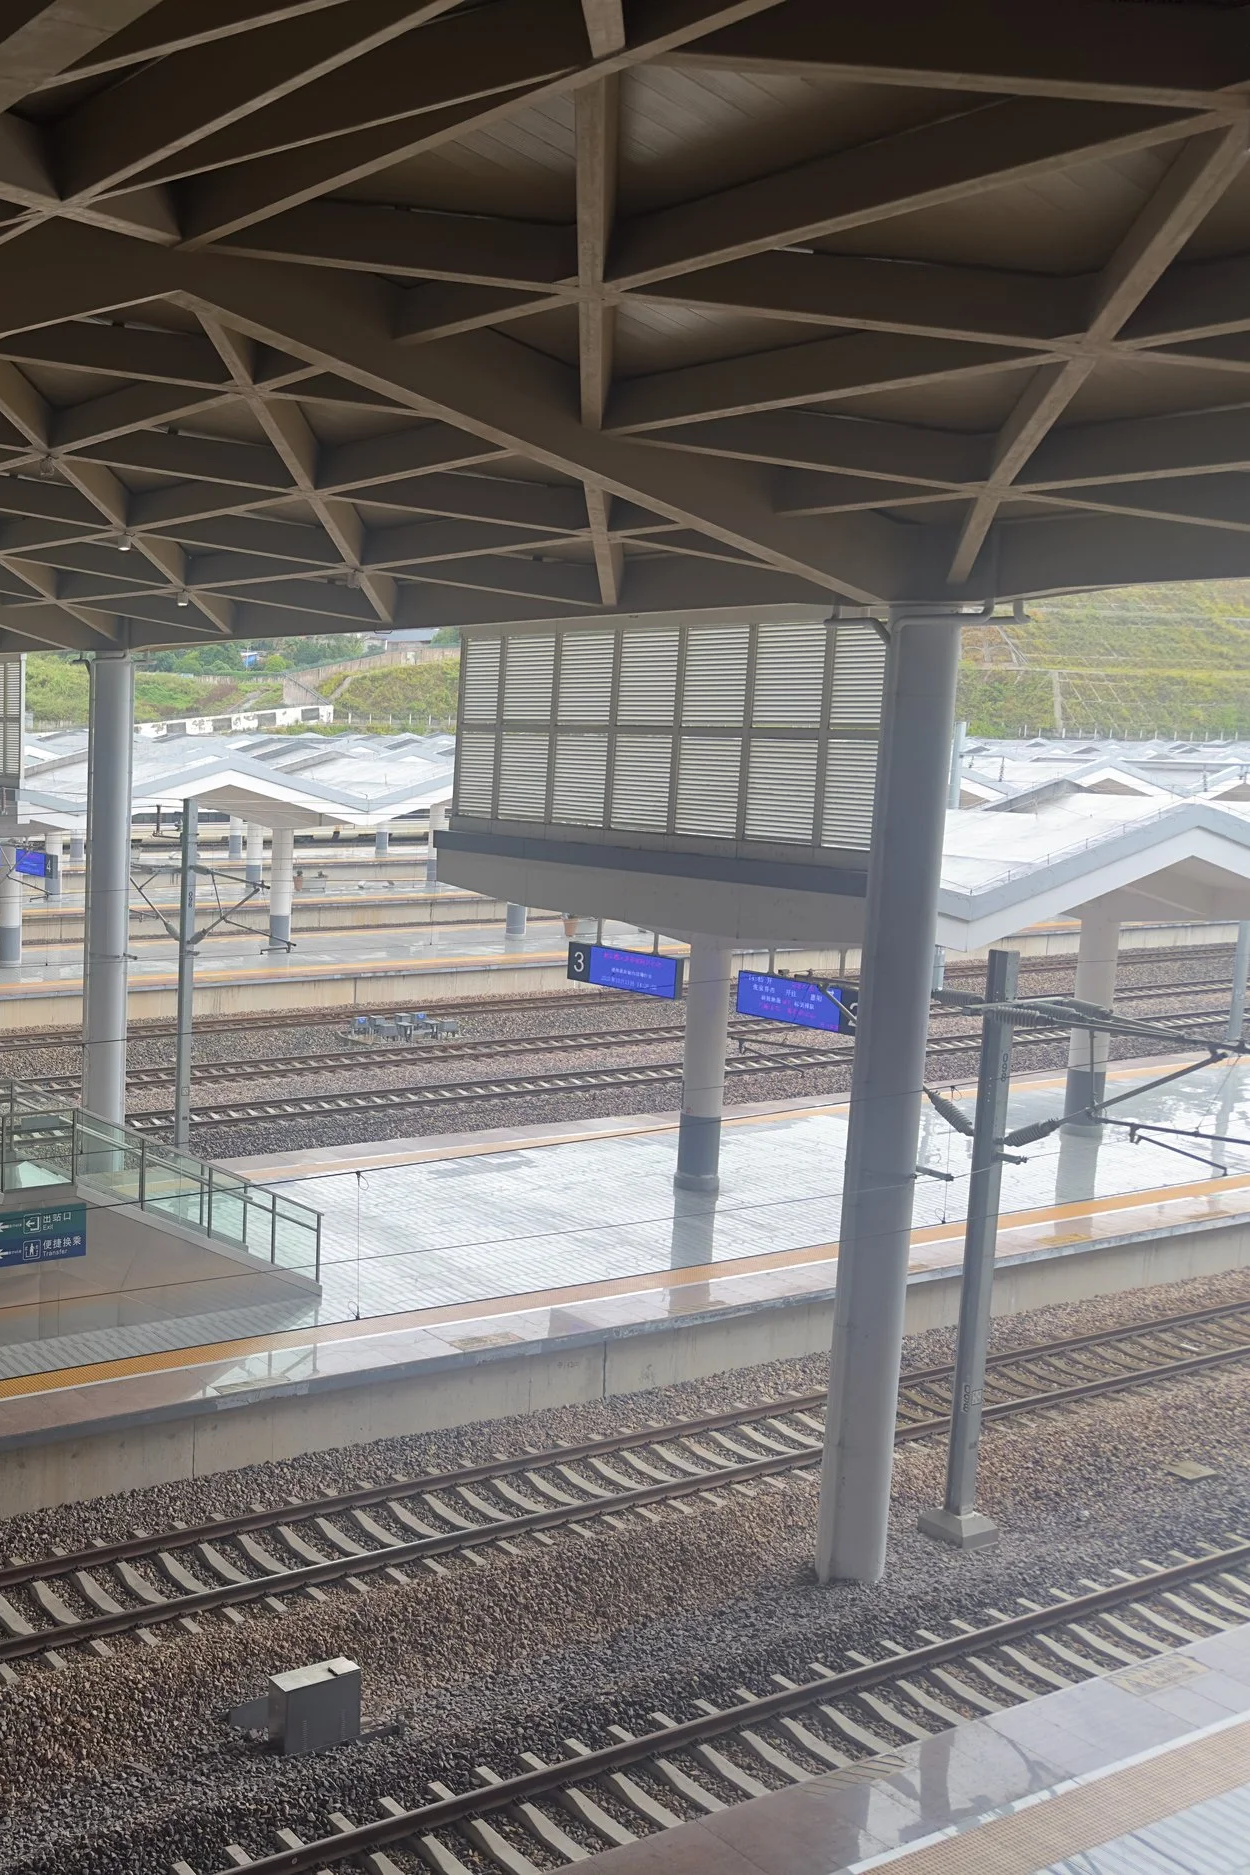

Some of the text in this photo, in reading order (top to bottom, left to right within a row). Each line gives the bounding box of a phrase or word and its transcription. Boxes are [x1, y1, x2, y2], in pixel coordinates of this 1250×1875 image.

[46, 859, 52, 872] 4
[573, 951, 584, 972] 3
[43, 1212, 71, 1223] 出站口
[43, 1235, 81, 1250] 便捷换乘
[43, 1248, 68, 1257] Transfer
